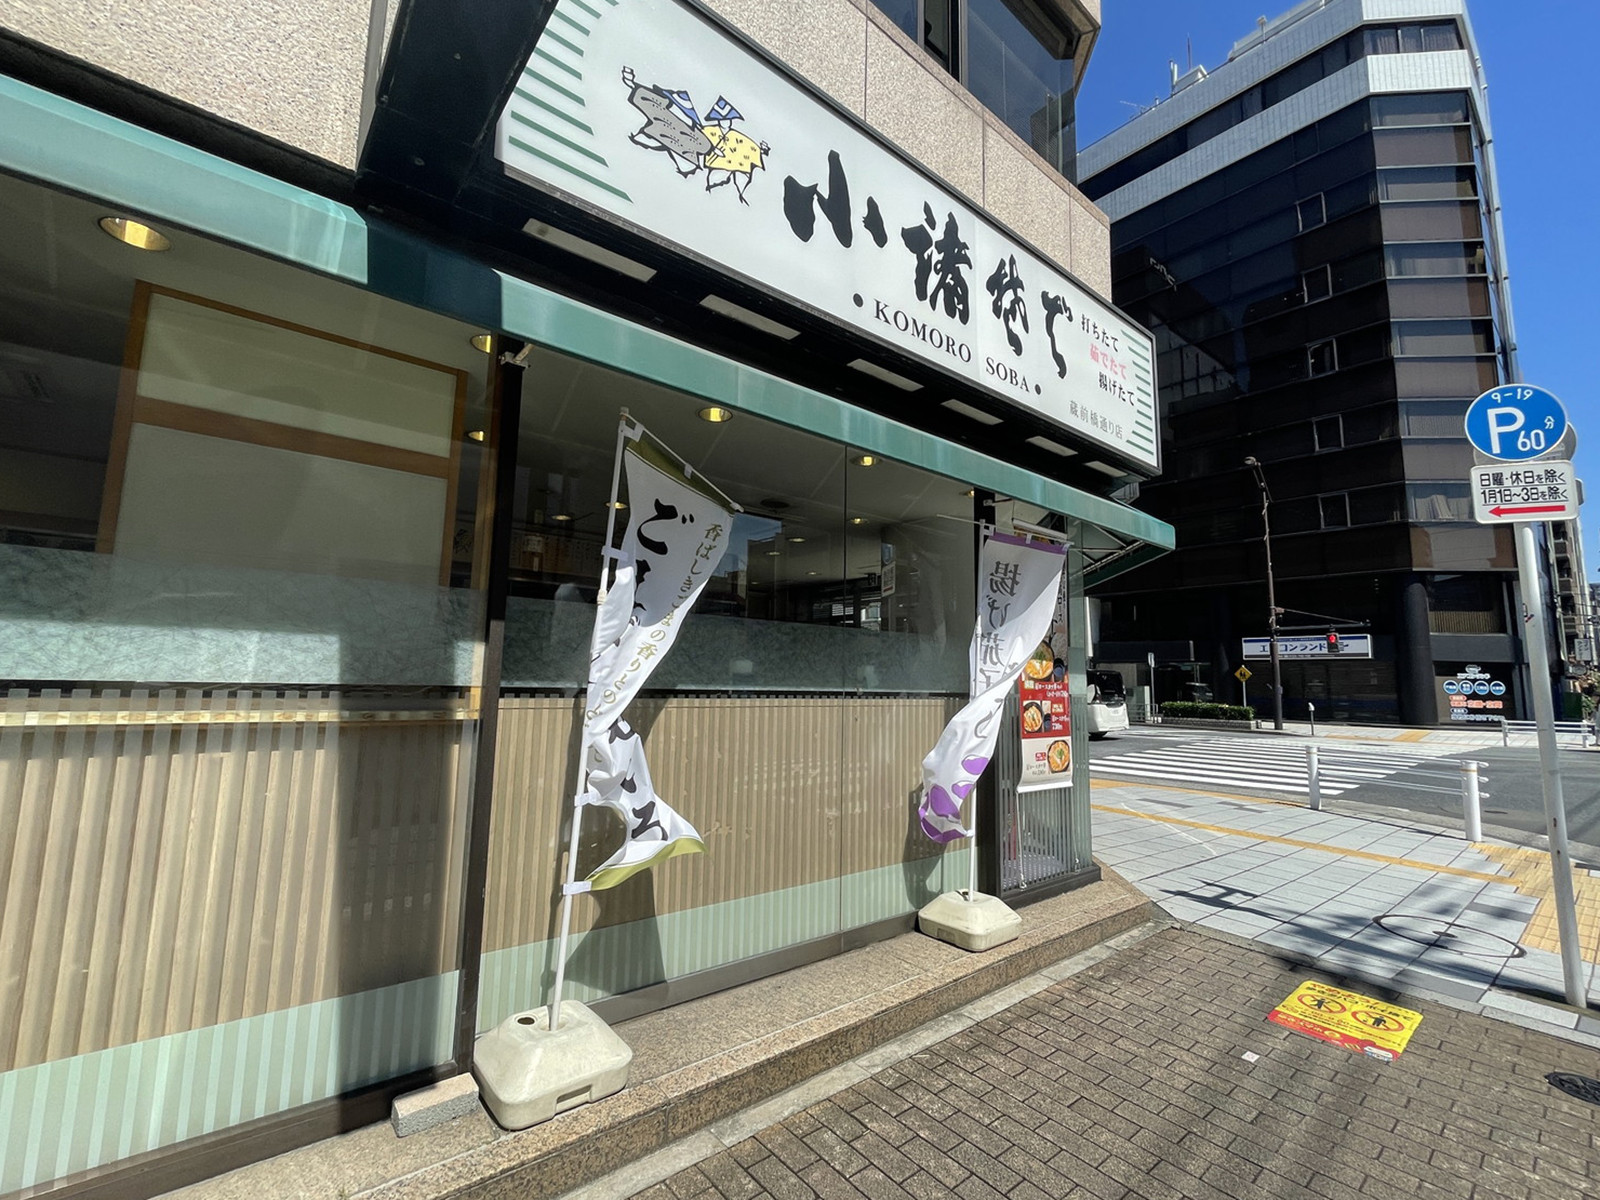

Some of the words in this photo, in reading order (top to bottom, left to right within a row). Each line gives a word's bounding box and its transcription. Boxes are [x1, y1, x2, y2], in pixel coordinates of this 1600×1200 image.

[874, 299, 972, 363] KOMORO
[986, 357, 1030, 393] SOBA
[1081, 313, 1119, 353] 打ちたて
[1090, 343, 1127, 380] 茹でたて
[1098, 371, 1135, 407] 揚げたて
[1491, 388, 1533, 403] 9-19
[1069, 400, 1123, 440] 蔵前橋通り店
[1487, 407, 1525, 454] P
[1260, 642, 1349, 653] エコンランドー
